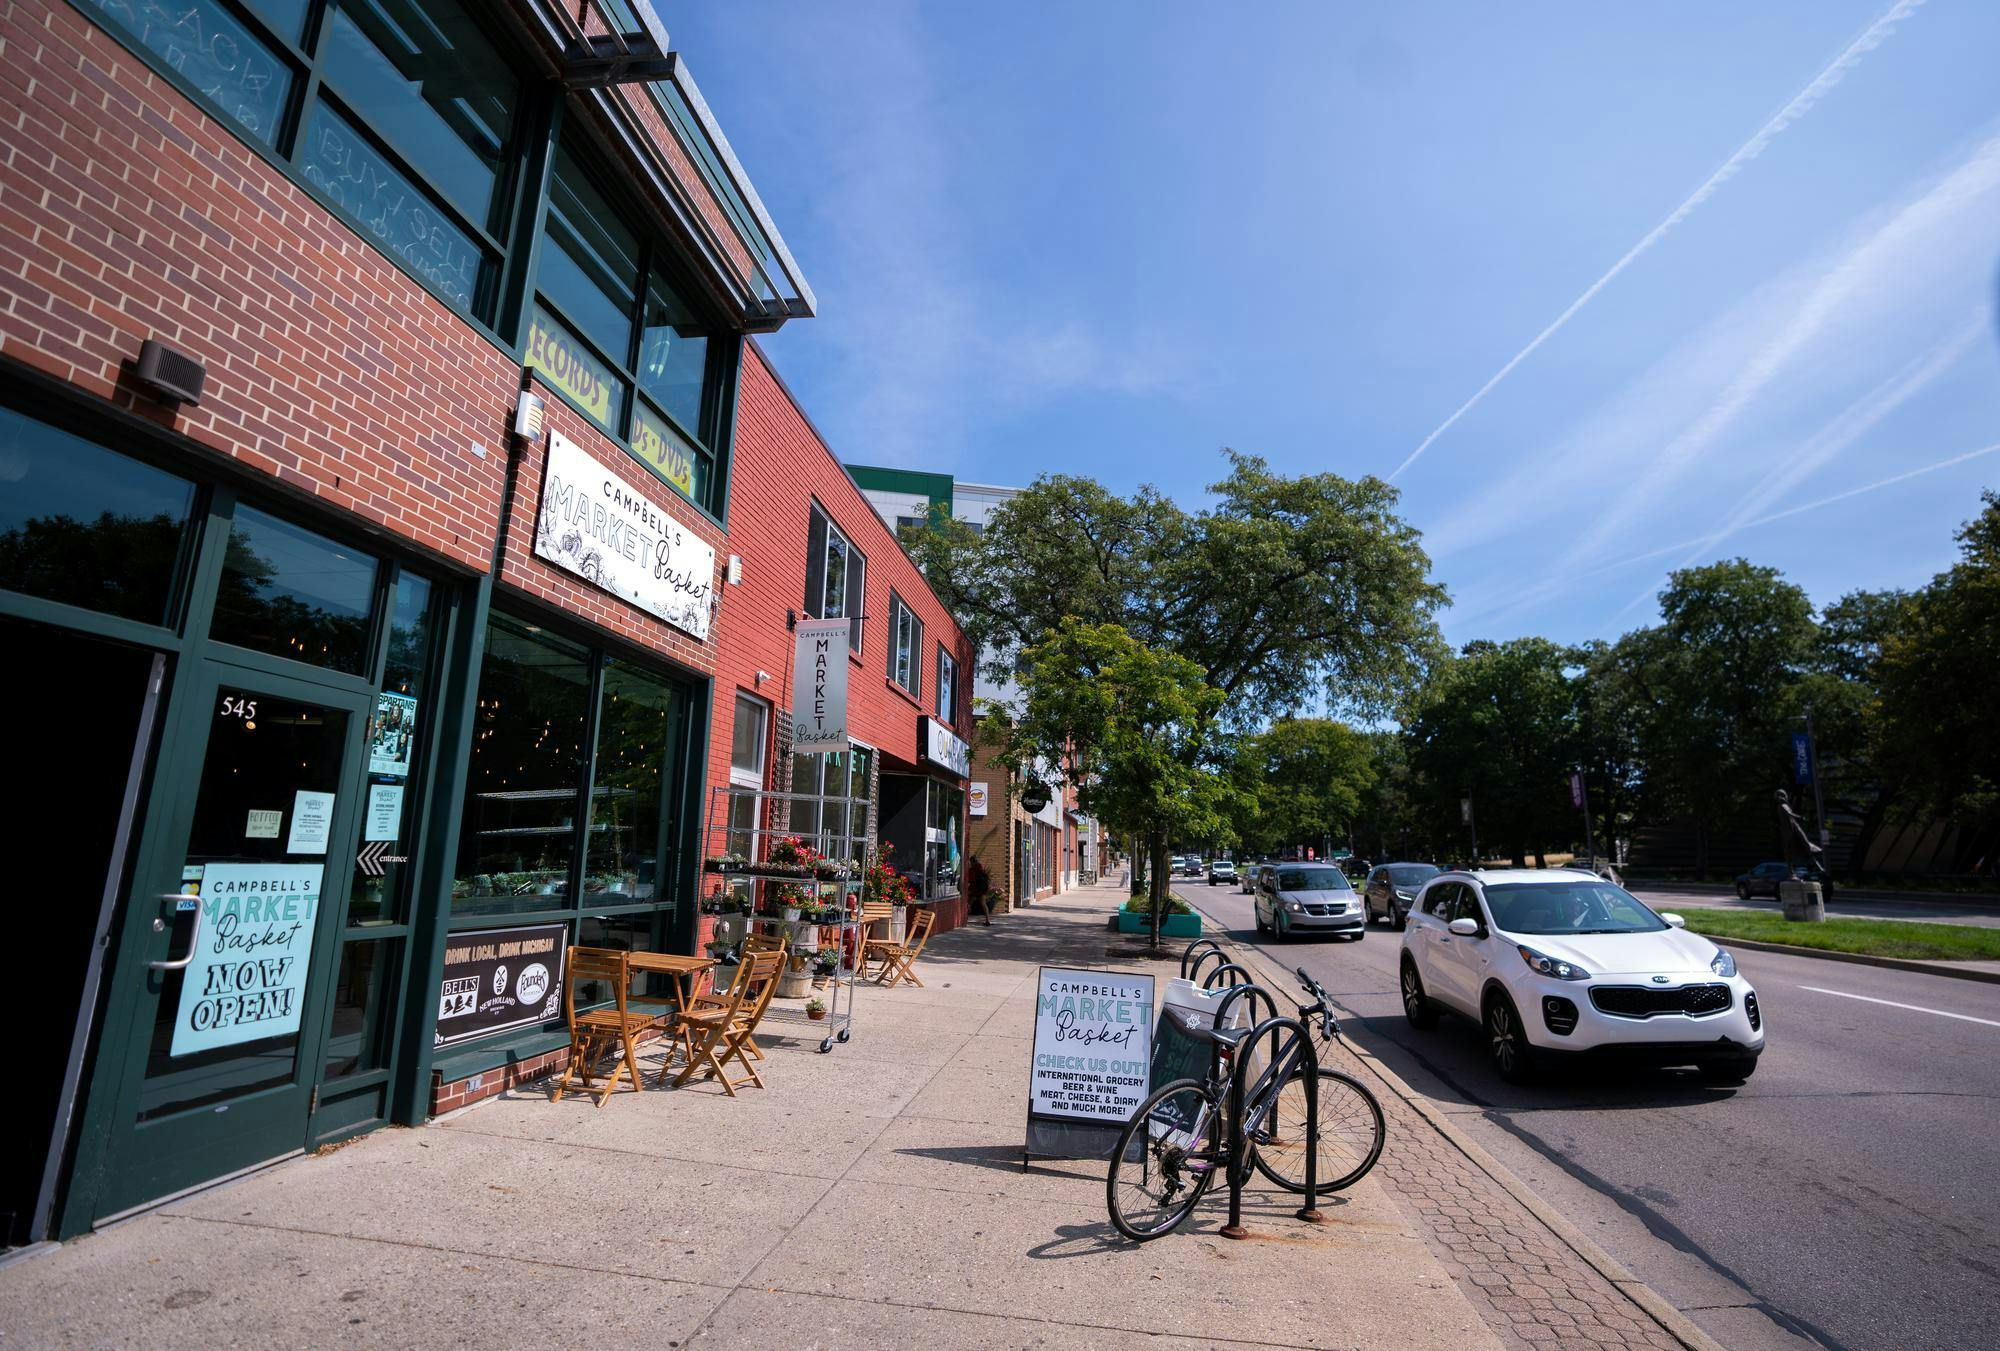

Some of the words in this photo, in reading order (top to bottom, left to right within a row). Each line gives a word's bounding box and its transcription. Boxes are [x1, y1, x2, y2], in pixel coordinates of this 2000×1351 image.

[657, 432, 688, 484] DVDs
[550, 476, 653, 568] MARKET
[604, 481, 681, 547] CAMPBELL'S
[654, 540, 710, 604] Basket
[814, 639, 829, 731] MARKET
[221, 696, 257, 720] 545
[378, 694, 415, 711] SPARTANS
[796, 723, 843, 744] Basket
[380, 854, 407, 863] entrance
[213, 880, 311, 893] CAMPBELL'S
[202, 894, 320, 924] MARKET
[213, 913, 302, 954] Basket
[444, 948, 471, 966] DRINK
[471, 944, 497, 962] LOCAL,
[498, 942, 521, 959] DRINK
[522, 938, 554, 956] MICHIGAN
[203, 957, 293, 996] NOW
[445, 979, 476, 995] BELL'S
[1050, 983, 1141, 998] CAMPBELL'S
[190, 988, 295, 1032] OPEN!
[480, 999, 492, 1013] NEW
[492, 996, 516, 1006] HOLLAND
[1038, 994, 1152, 1025] MARKET
[1055, 1009, 1138, 1049] Basket
[1037, 1053, 1086, 1071] CHECK
[1087, 1057, 1107, 1072] US
[1110, 1059, 1147, 1075] OUT!
[1037, 1070, 1103, 1084] INTERNATIONAL
[1106, 1075, 1144, 1087] GROCERY
[1063, 1083, 1085, 1091] BEER
[1087, 1084, 1093, 1092] &
[1096, 1086, 1118, 1094] WINE
[1051, 1101, 1070, 1110] AND
[1071, 1102, 1096, 1112] MUCH
[1098, 1104, 1126, 1115] MORE!
[1105, 1095, 1111, 1103] &
[1114, 1097, 1139, 1106] DIARY
